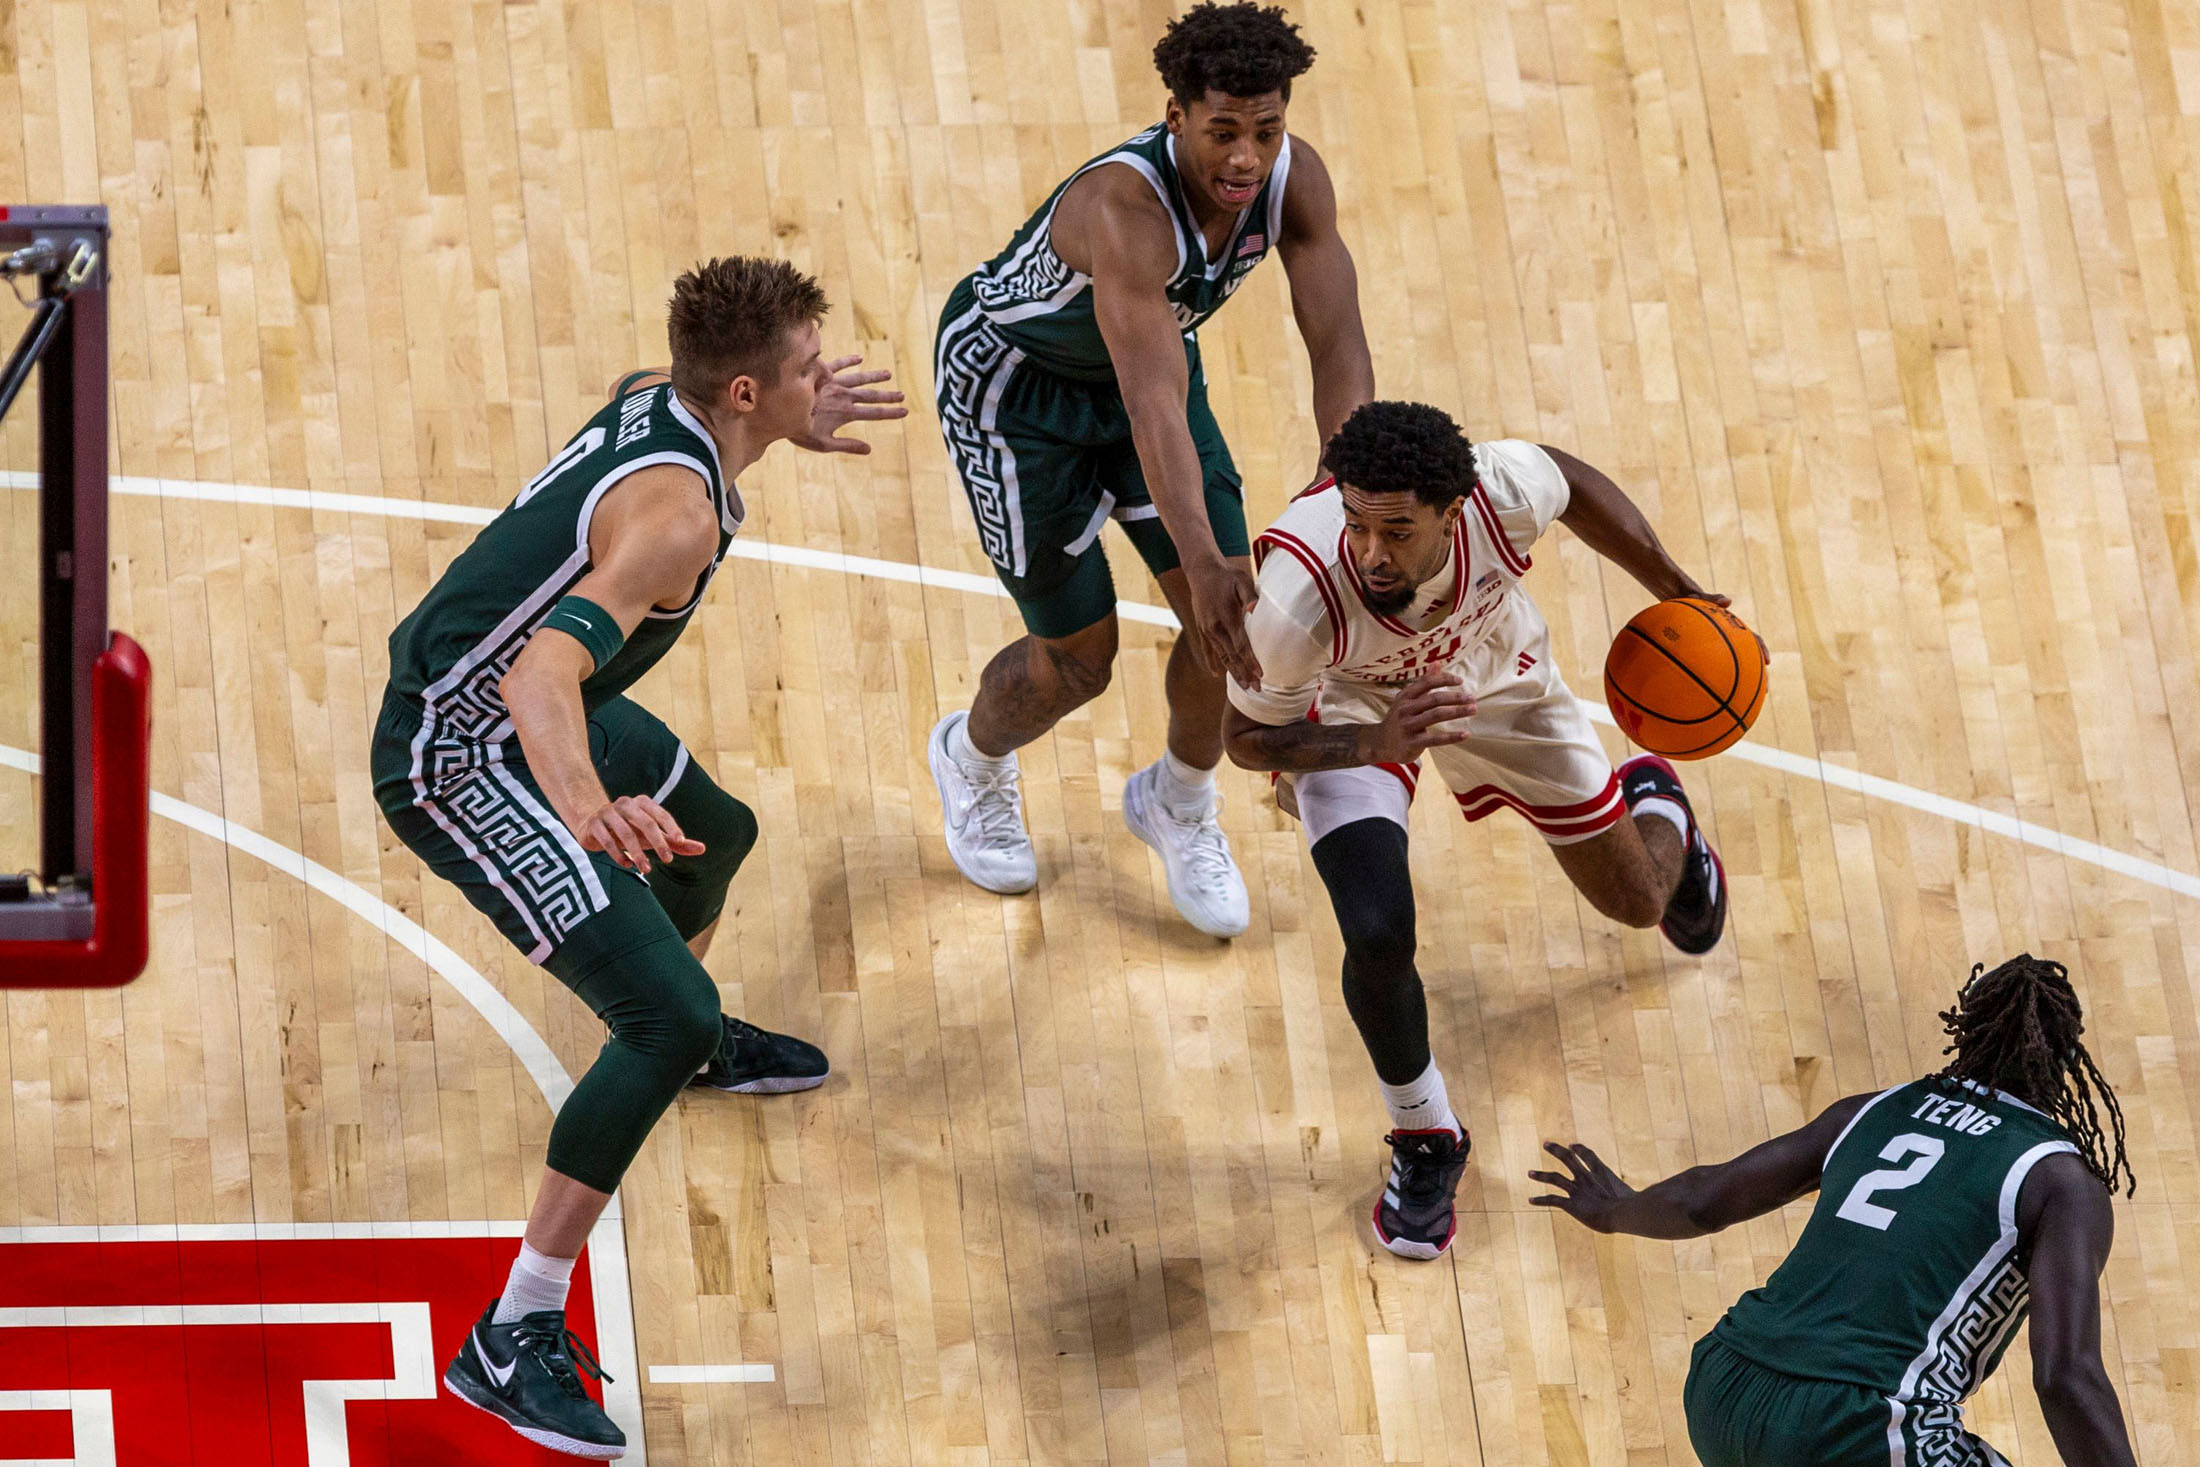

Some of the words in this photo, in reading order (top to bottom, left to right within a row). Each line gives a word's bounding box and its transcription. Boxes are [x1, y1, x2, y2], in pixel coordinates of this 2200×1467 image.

[515, 427, 607, 510] 0
[1911, 1093, 2001, 1136] TENG
[1835, 1132, 1945, 1231] 2
